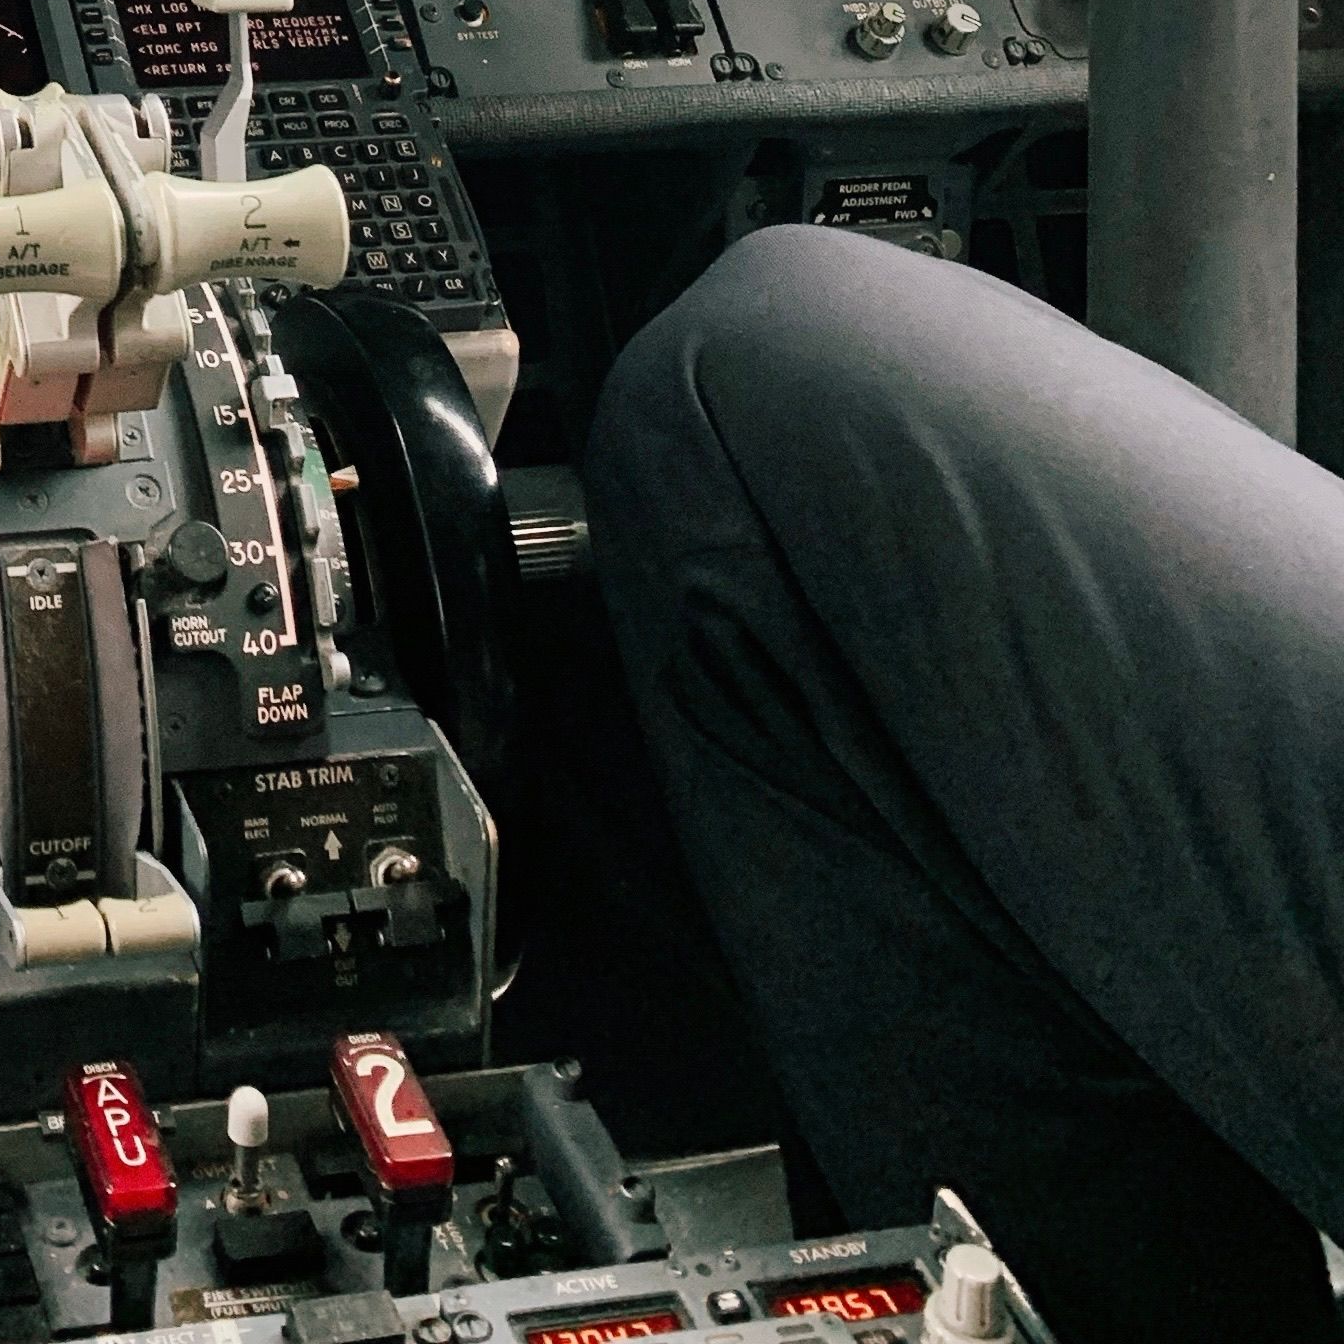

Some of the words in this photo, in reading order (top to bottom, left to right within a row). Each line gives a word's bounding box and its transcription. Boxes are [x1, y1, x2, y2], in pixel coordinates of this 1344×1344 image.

[839, 181, 878, 194] RUDDER
[880, 180, 912, 192] PEDAL
[841, 194, 908, 207] ADJUSTMENT
[240, 194, 267, 229] 2
[8, 244, 40, 260] A/T
[240, 237, 272, 252] A/T
[210, 256, 298, 272] DISENGAGE
[195, 351, 220, 368] 10
[213, 406, 236, 425] 15
[220, 473, 251, 493] 25
[229, 542, 264, 565] 30
[29, 595, 63, 610] IDLE
[172, 617, 208, 631] HORN
[174, 629, 226, 646] CUTOUT
[242, 629, 278, 655] 40
[258, 684, 303, 705] FLAP
[258, 705, 308, 724] DOWN
[255, 770, 302, 792] STAB
[309, 765, 354, 785] TRIM
[300, 813, 348, 827] NORMAL
[29, 838, 92, 856] CUTOFF
[347, 1032, 381, 1045] DISCH
[83, 1062, 117, 1075] DISCH
[355, 1053, 436, 1138] 2
[97, 1078, 146, 1167] APU
[790, 1240, 867, 1265] STANDBY
[555, 1274, 619, 1297] ACTIVE
